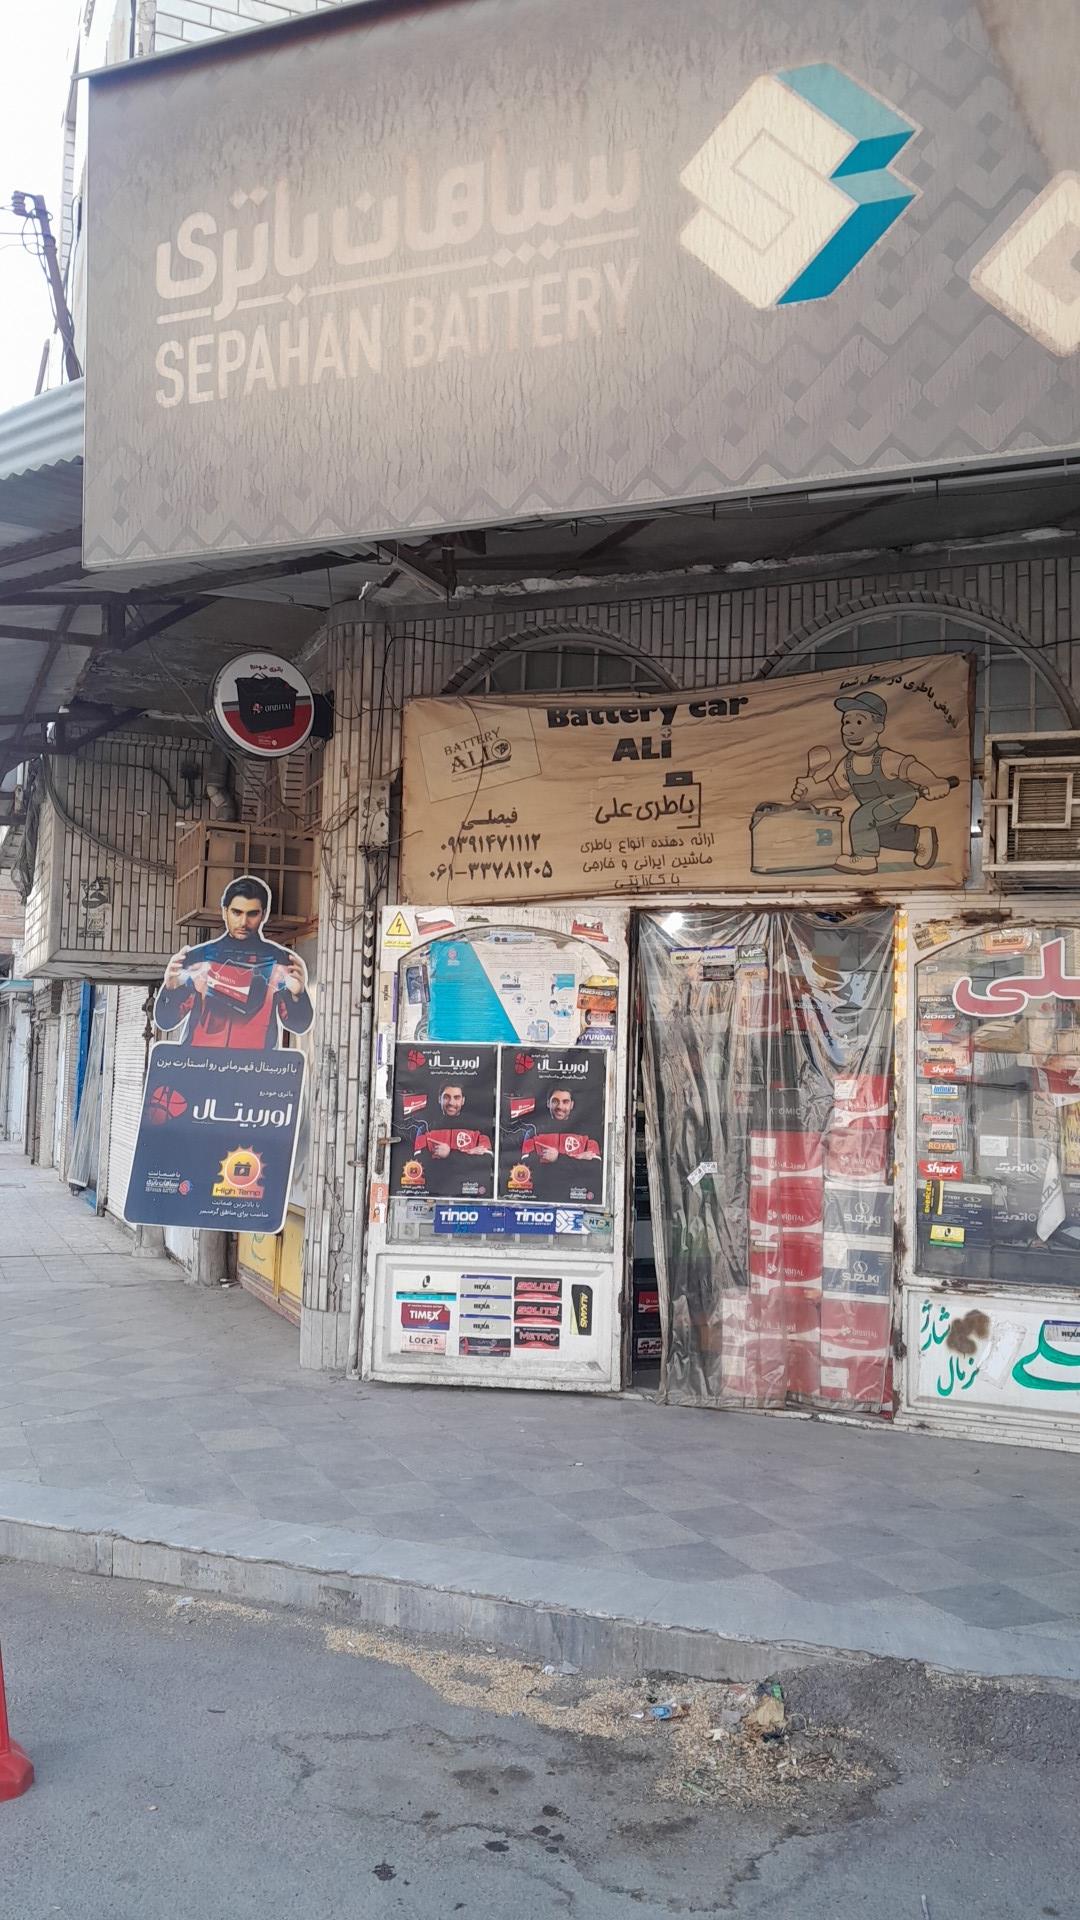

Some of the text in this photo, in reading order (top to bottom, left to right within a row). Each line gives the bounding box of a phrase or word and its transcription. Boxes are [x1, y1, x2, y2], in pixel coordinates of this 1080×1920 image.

[155, 137, 641, 321] سپاهان باتری
[155, 258, 641, 409] SEPAHAN BATTERY
[903, 681, 935, 702] باطری
[546, 696, 749, 729] Battery car
[444, 726, 501, 756] BATTERY
[451, 746, 490, 774] ALI
[461, 807, 518, 831] فیصلی
[595, 793, 696, 824] باطری علی
[440, 833, 541, 854] ۰۹۳۹۱۴۷۱۱۱۲
[580, 832, 715, 854] ارائه دهنده انواع باطری
[582, 851, 714, 873] ماشین ایرانی و خارجی
[670, 873, 681, 887] با
[952, 937, 1080, 1018] لی
[156, 1058, 298, 1075] با اوربیتال قهرمانی رو استارت بزن
[428, 1055, 480, 1070] اوربیتال
[537, 1059, 589, 1074] اوربیتال
[192, 1098, 294, 1128] اوربیتال
[843, 1213, 881, 1224] SUZUKI
[842, 1272, 880, 1283] SUZUKI
[409, 1308, 442, 1323] TIMEX
